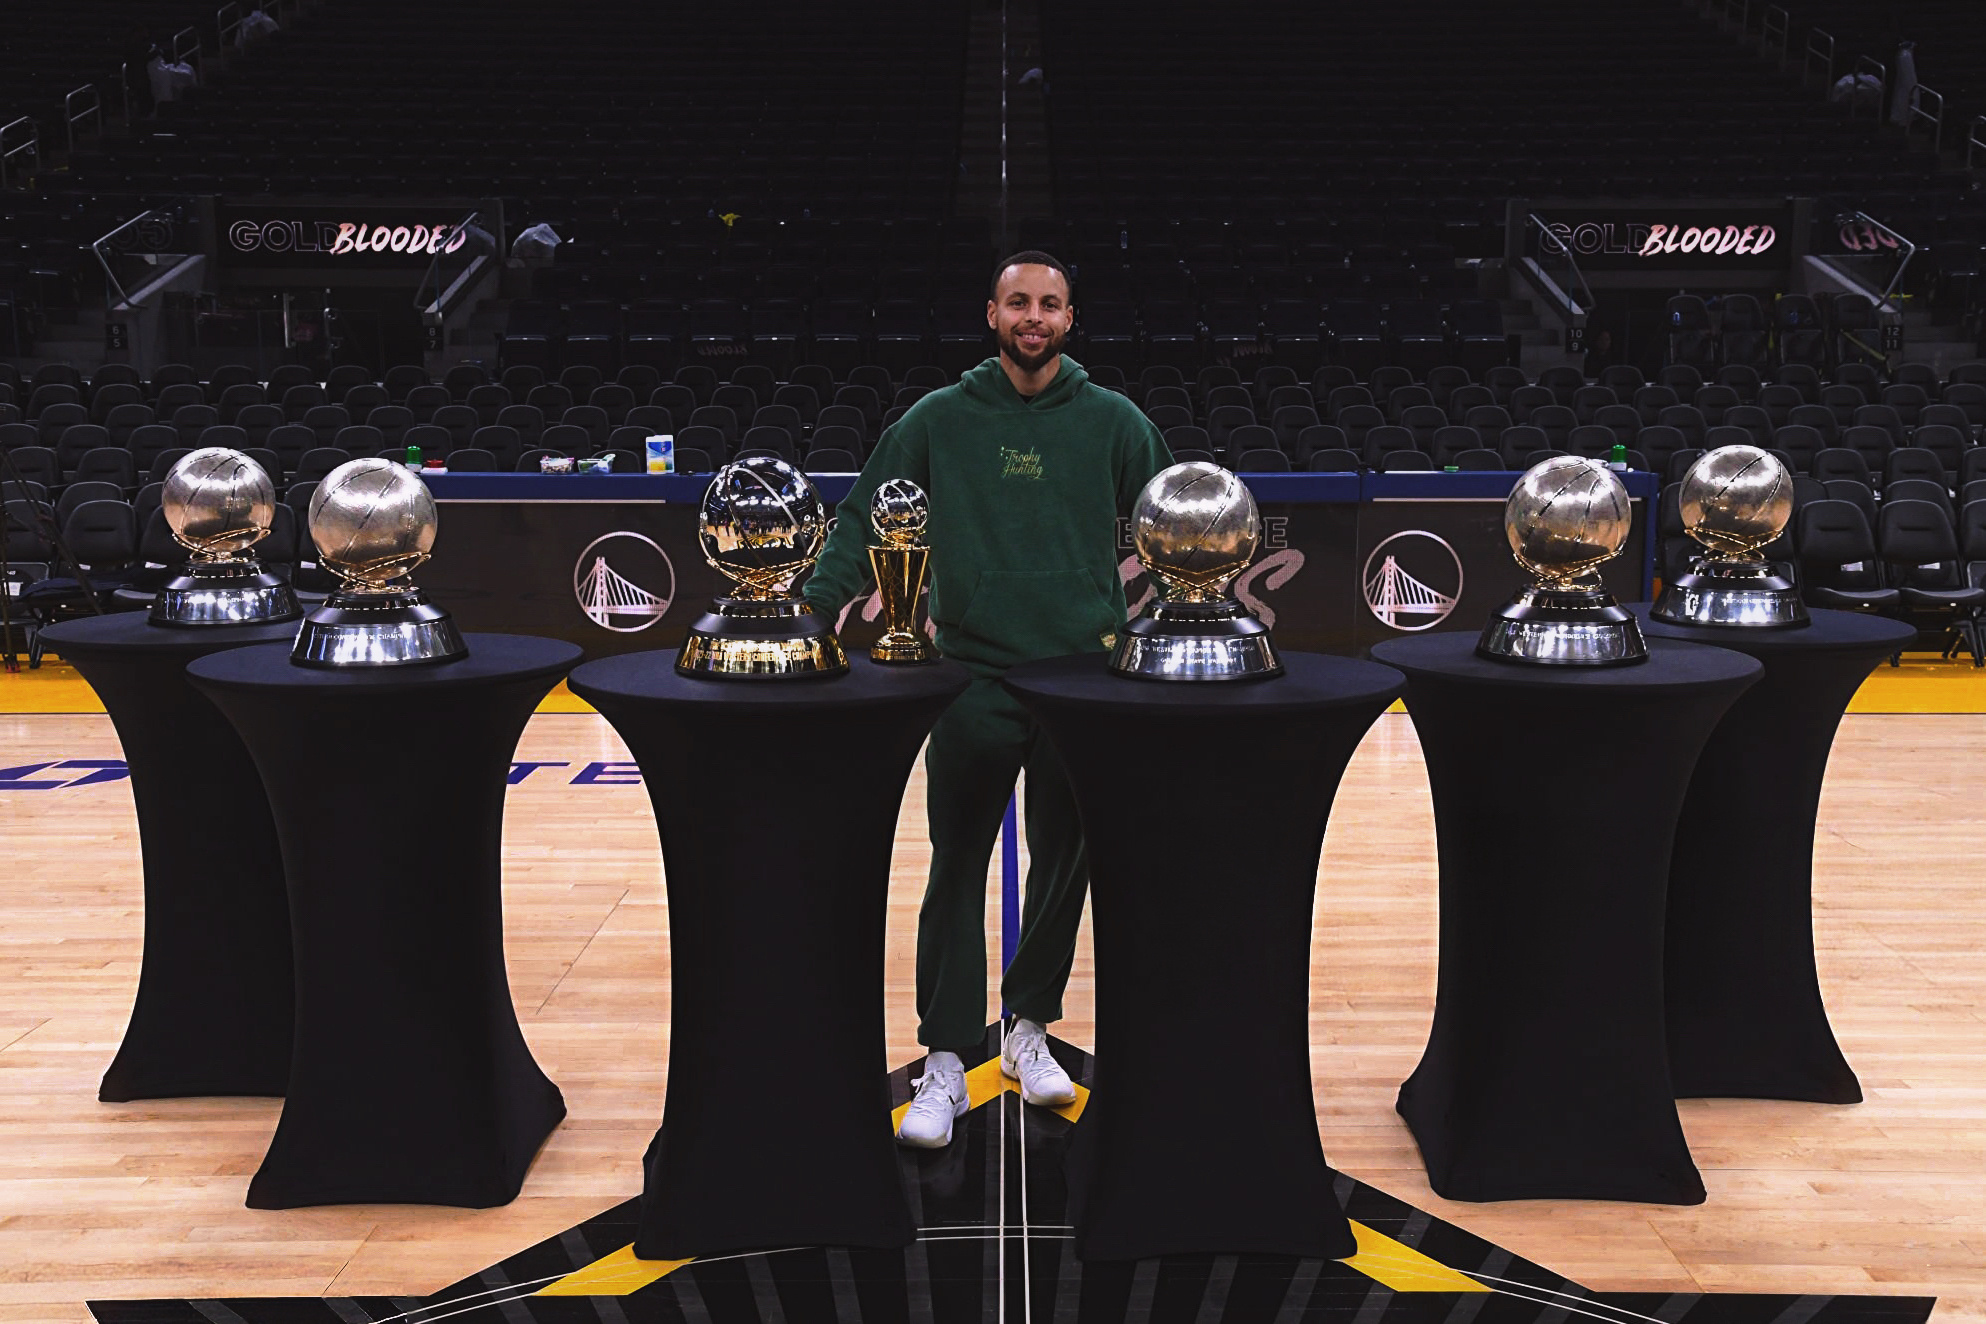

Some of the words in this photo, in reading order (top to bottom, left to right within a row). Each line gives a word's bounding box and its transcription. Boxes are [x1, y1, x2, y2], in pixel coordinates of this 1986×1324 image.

[229, 220, 340, 252] GOLD
[330, 222, 466, 255] BLOODED
[1540, 222, 1654, 254] GOLD
[1638, 224, 1776, 256] BLOODED
[112, 325, 119, 335] 6
[1570, 329, 1583, 339] 10
[1886, 326, 1900, 337] 12
[113, 338, 121, 348] 5
[429, 340, 437, 350] 7
[1571, 342, 1579, 351] 9
[1885, 339, 1898, 349] 11
[1005, 446, 1041, 466] Trophy
[1001, 462, 1047, 480] Hunting
